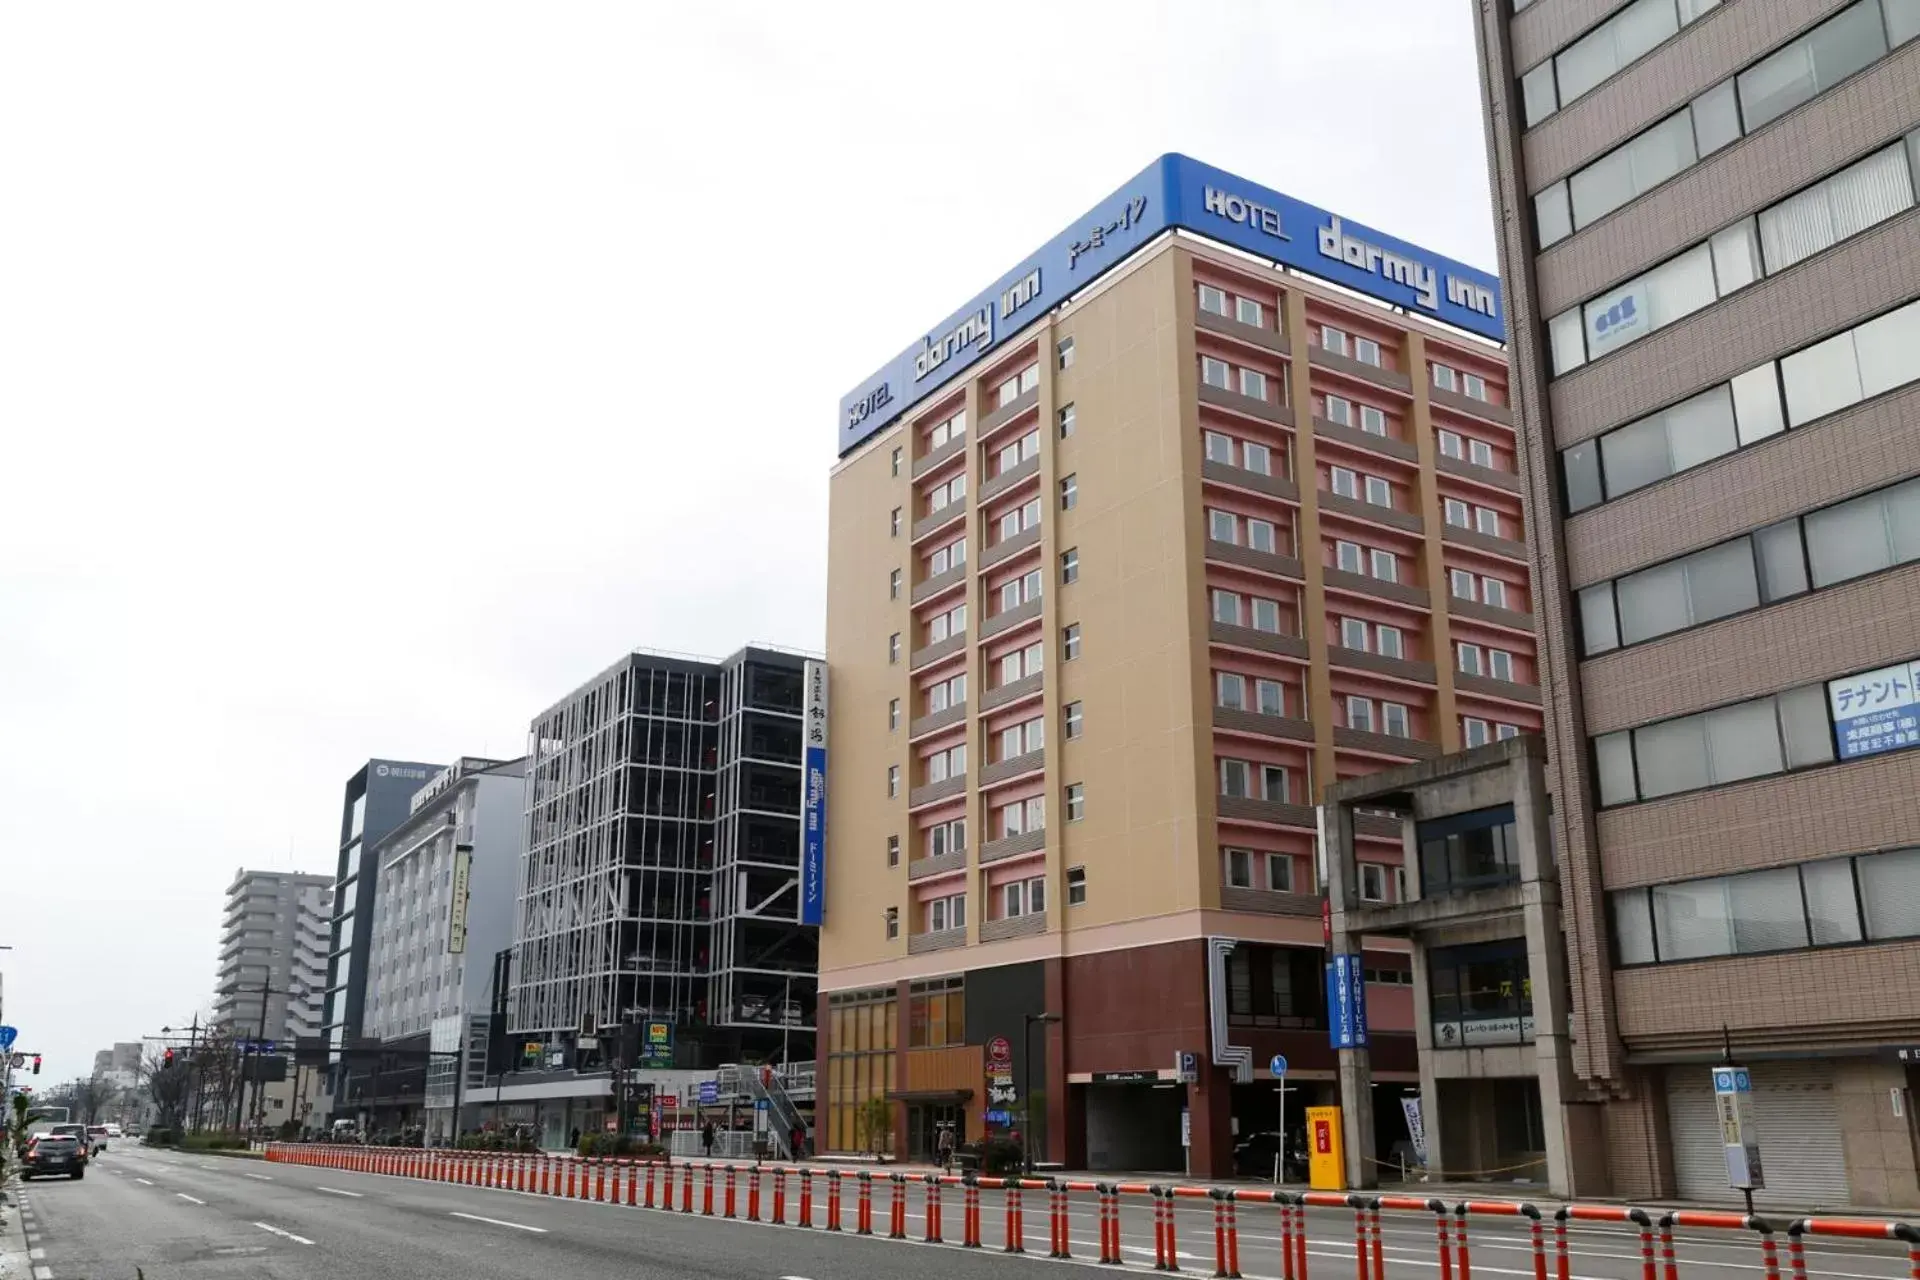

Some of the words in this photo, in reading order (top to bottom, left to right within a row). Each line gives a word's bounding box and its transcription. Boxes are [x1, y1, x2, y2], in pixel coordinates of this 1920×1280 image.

[1068, 195, 1148, 270] ドーミーイン
[1204, 184, 1293, 242] HOTEL
[1317, 216, 1439, 311] dormy
[1445, 274, 1496, 318] inn
[914, 301, 995, 383] dormy
[1001, 267, 1043, 320] inn
[847, 382, 895, 430] HOTEL
[1838, 678, 1907, 712] テナント
[1183, 1054, 1194, 1072] P
